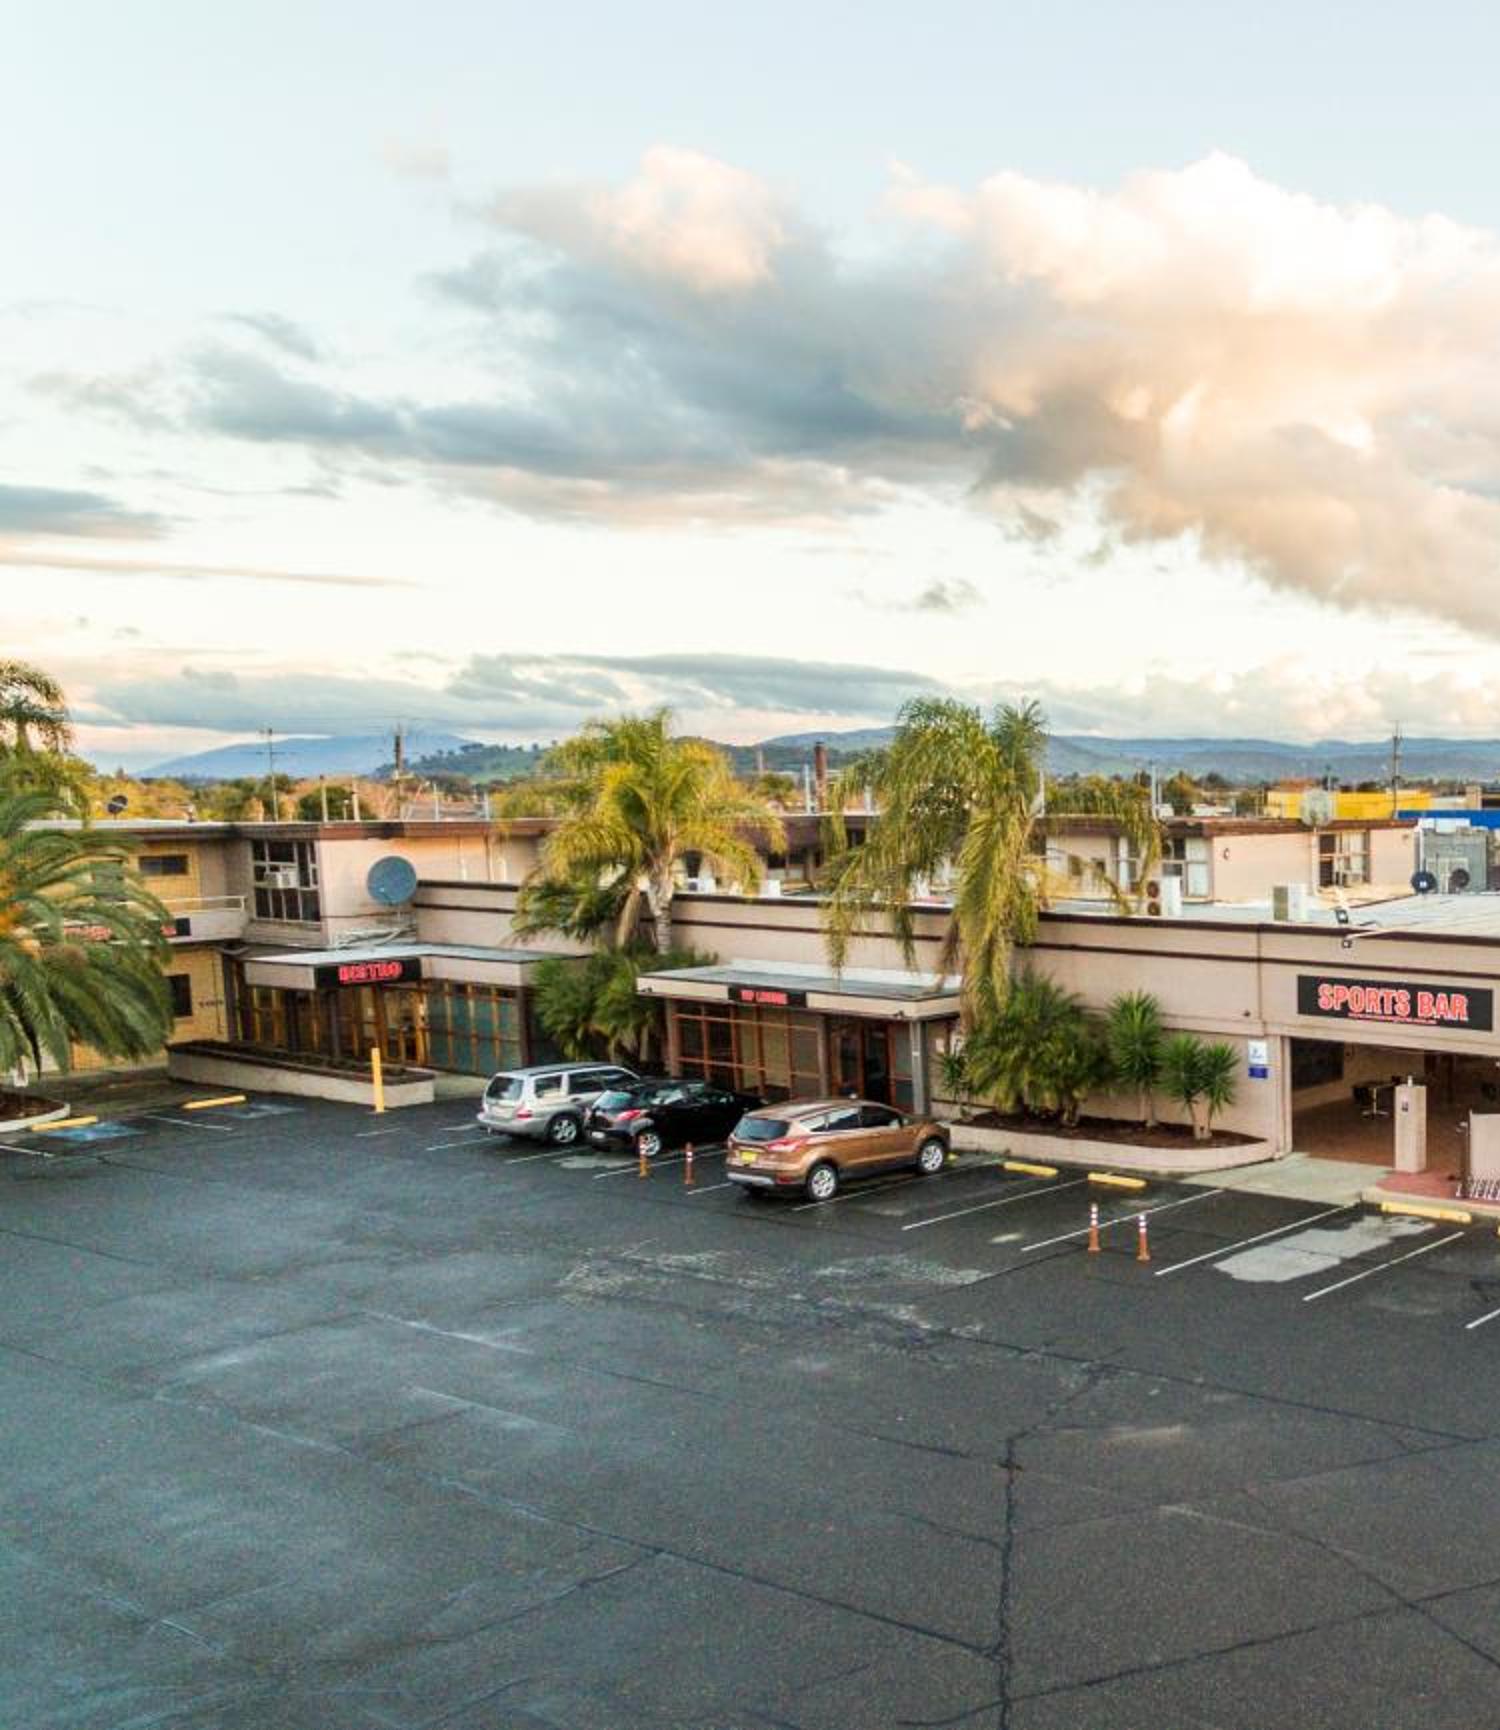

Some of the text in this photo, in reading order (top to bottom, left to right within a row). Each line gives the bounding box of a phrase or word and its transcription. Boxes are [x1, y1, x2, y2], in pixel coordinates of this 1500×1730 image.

[338, 961, 402, 984] BISTRO
[1318, 984, 1410, 1016] SPORTS
[1417, 991, 1468, 1021] BAR
